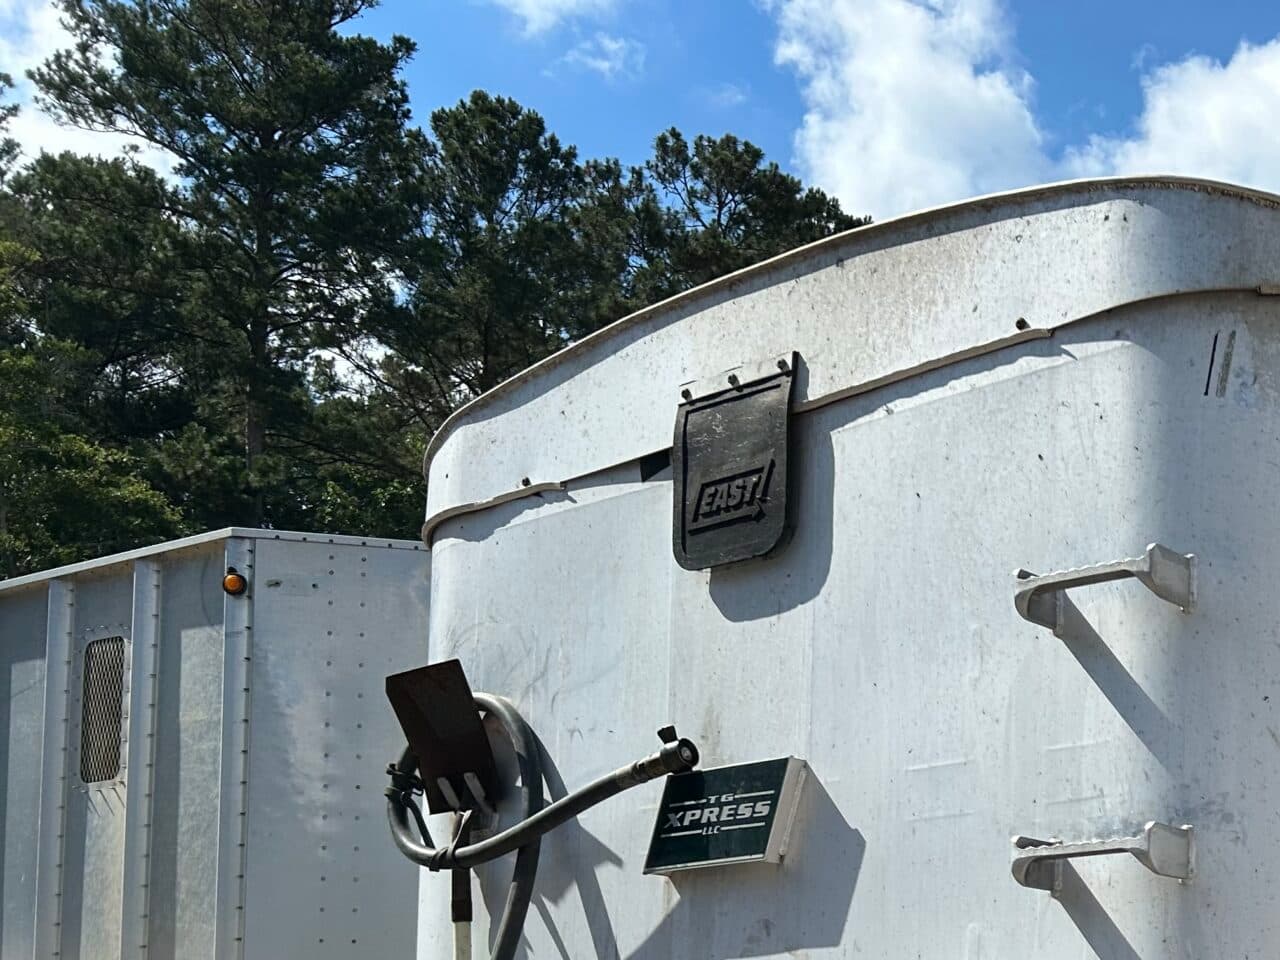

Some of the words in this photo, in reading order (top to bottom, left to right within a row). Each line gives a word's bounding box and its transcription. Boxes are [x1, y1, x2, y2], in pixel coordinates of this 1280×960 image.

[701, 475, 761, 517] EAST
[708, 793, 734, 804] TG
[664, 801, 771, 828] XPRESS
[702, 825, 721, 835] LLC
